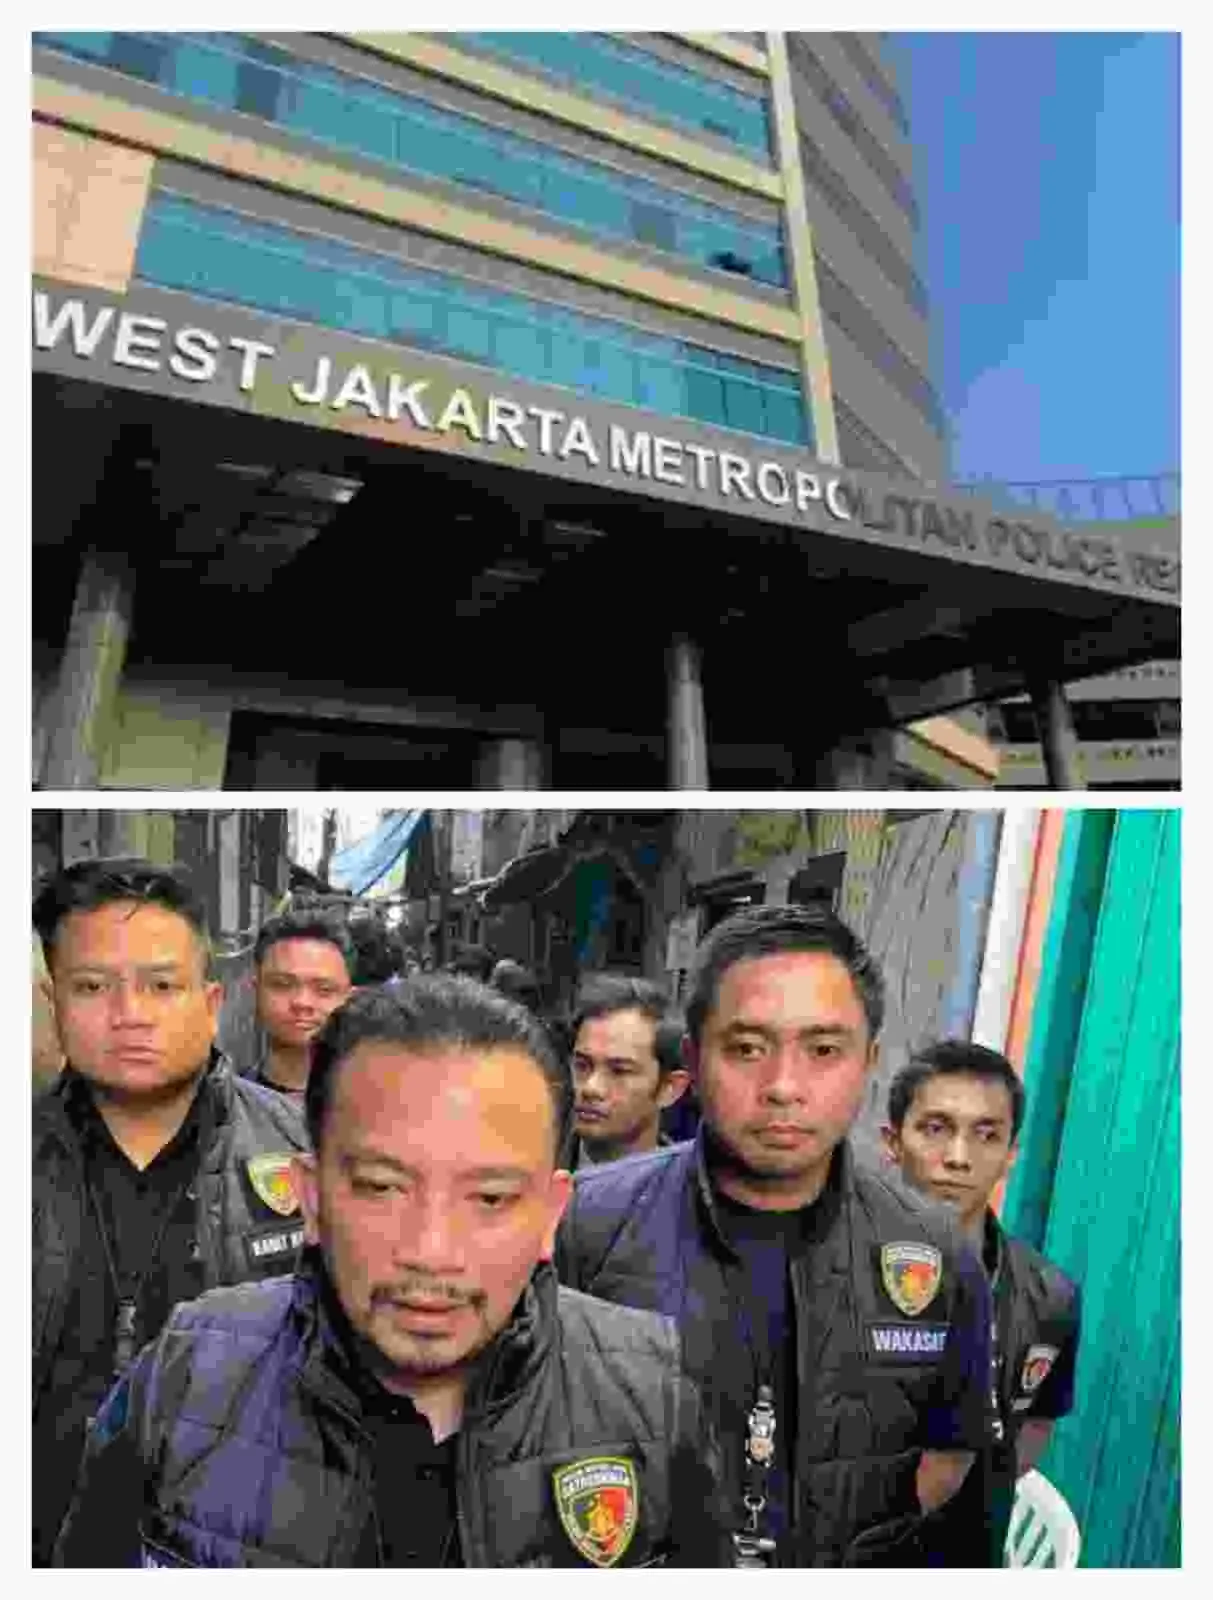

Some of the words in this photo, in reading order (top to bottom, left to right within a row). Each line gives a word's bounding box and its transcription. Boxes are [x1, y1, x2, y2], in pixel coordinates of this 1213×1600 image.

[34, 293, 274, 390] WEST
[291, 357, 599, 464] JAKARTA
[608, 426, 977, 555] METROPOLITAN
[983, 515, 1120, 583] POLICE
